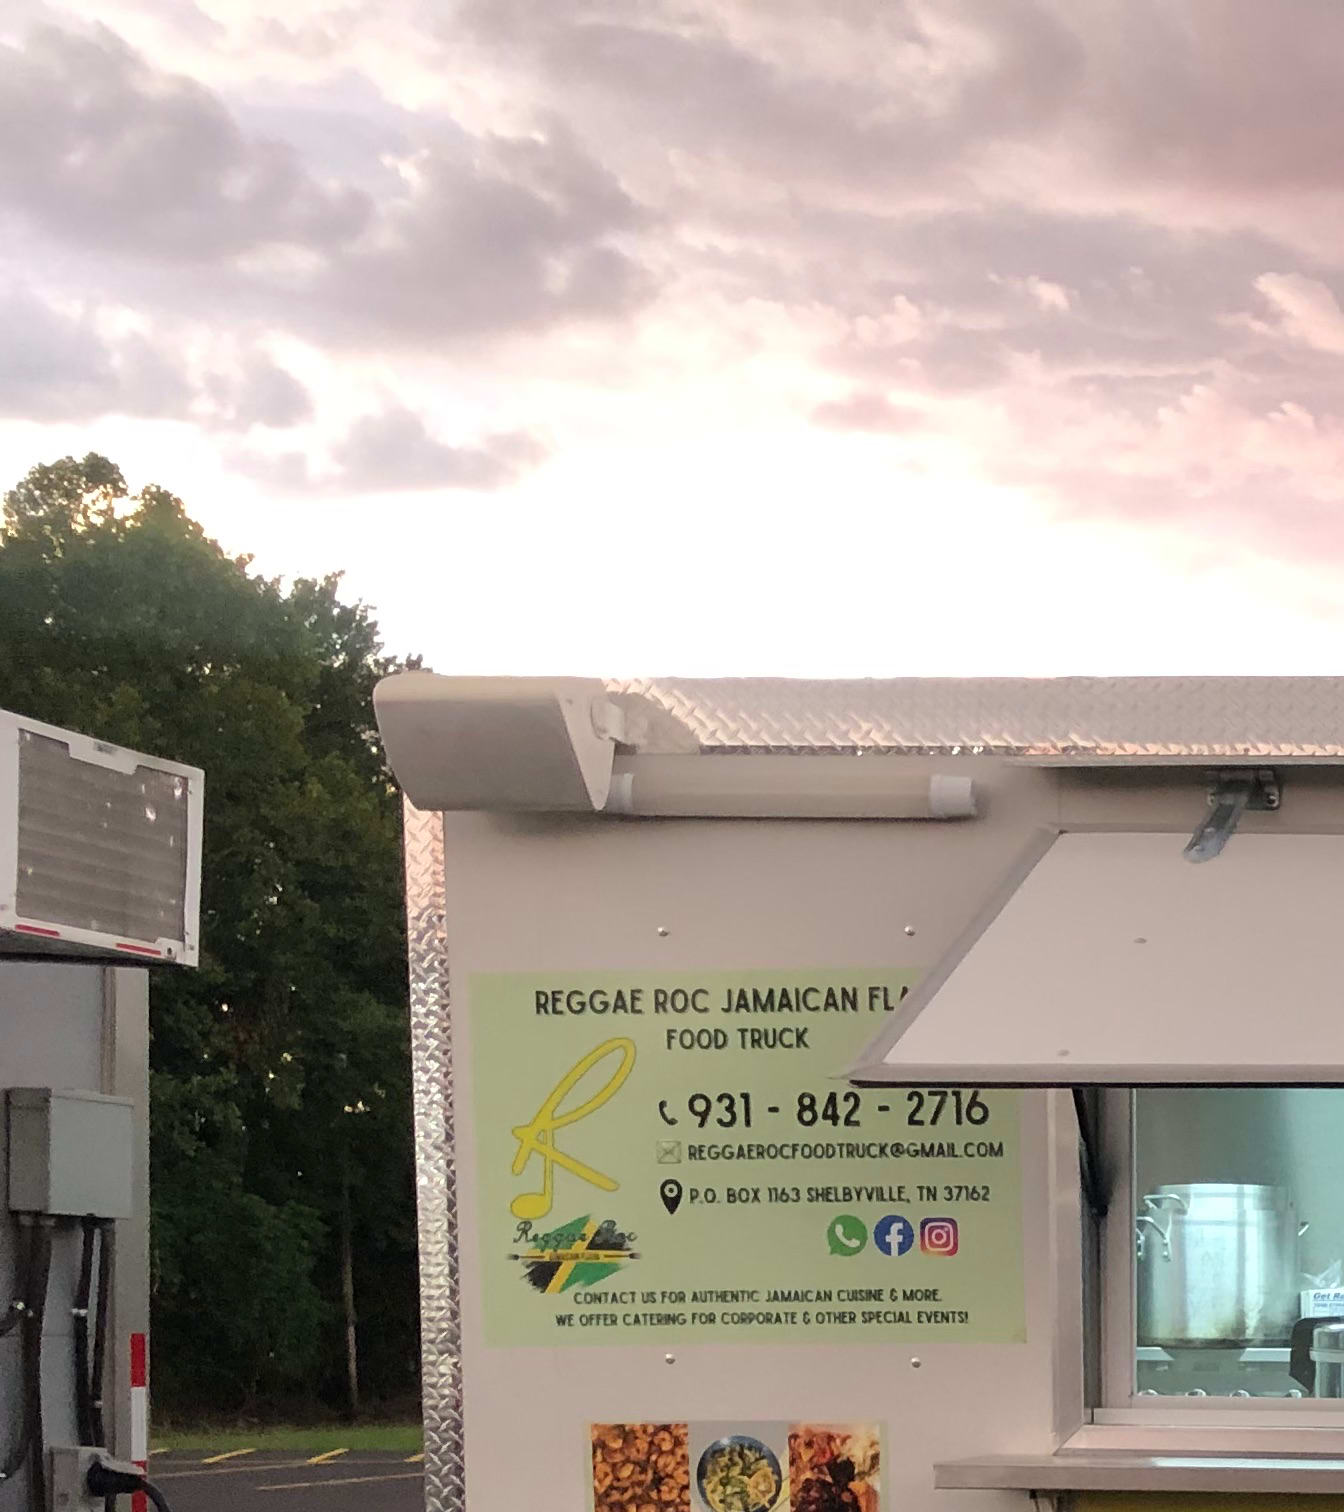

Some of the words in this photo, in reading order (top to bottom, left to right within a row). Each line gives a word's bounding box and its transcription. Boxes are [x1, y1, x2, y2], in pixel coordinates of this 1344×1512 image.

[535, 989, 644, 1015] REGGAE
[654, 989, 710, 1014] ROC
[721, 987, 858, 1013] JAMAICAN
[666, 1028, 728, 1050] FOOD
[737, 1027, 810, 1049] TRUCK
[688, 1092, 751, 1128] 931
[797, 1092, 861, 1127] 842
[907, 1090, 990, 1126] 2716
[688, 1141, 1004, 1161] REGGAEROCFOODTRUCK@GMAIL.COM
[690, 1188, 720, 1203] P.O.
[727, 1187, 760, 1203] BOX
[768, 1187, 800, 1203] 1163
[807, 1186, 911, 1204] SHELBYVILLE,
[917, 1185, 938, 1201] TN
[943, 1185, 991, 1201] 37162
[573, 1291, 636, 1305] CONTACT
[641, 1291, 657, 1304] US
[661, 1290, 686, 1304] FOR
[691, 1290, 760, 1303] AUTHENTIC
[765, 1289, 833, 1302] JAMAICAN
[837, 1288, 884, 1301] CUISINE
[889, 1288, 898, 1302] &
[555, 1314, 574, 1326] WE
[579, 1313, 618, 1326] OFFER
[622, 1313, 687, 1326] CATERING
[691, 1312, 716, 1325] FOR
[721, 1311, 797, 1325] CORPORATE
[802, 1311, 811, 1325] &
[815, 1311, 857, 1324] OTHER
[861, 1311, 912, 1324] SPECIAL
[916, 1310, 969, 1324] EVENTS!
